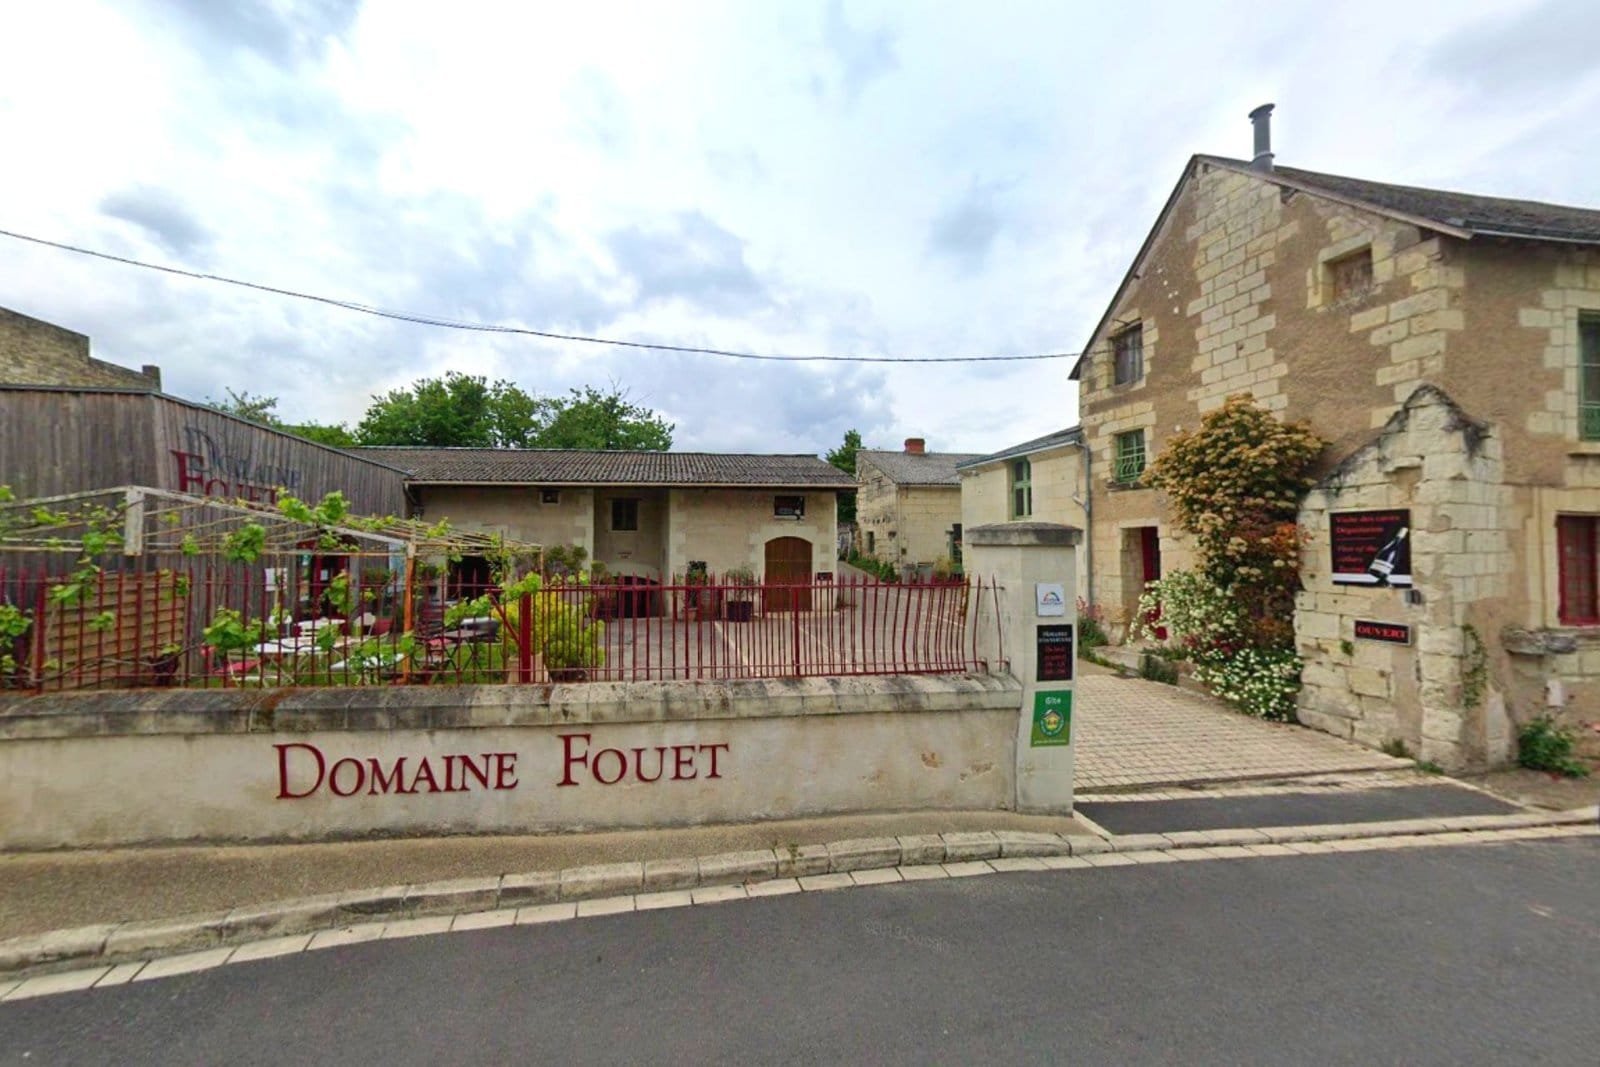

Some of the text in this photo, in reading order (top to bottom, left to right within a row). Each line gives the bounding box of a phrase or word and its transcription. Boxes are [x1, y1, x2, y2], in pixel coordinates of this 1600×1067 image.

[1356, 626, 1406, 639] OUVERT
[272, 733, 730, 800] DOMAINE FOUET
